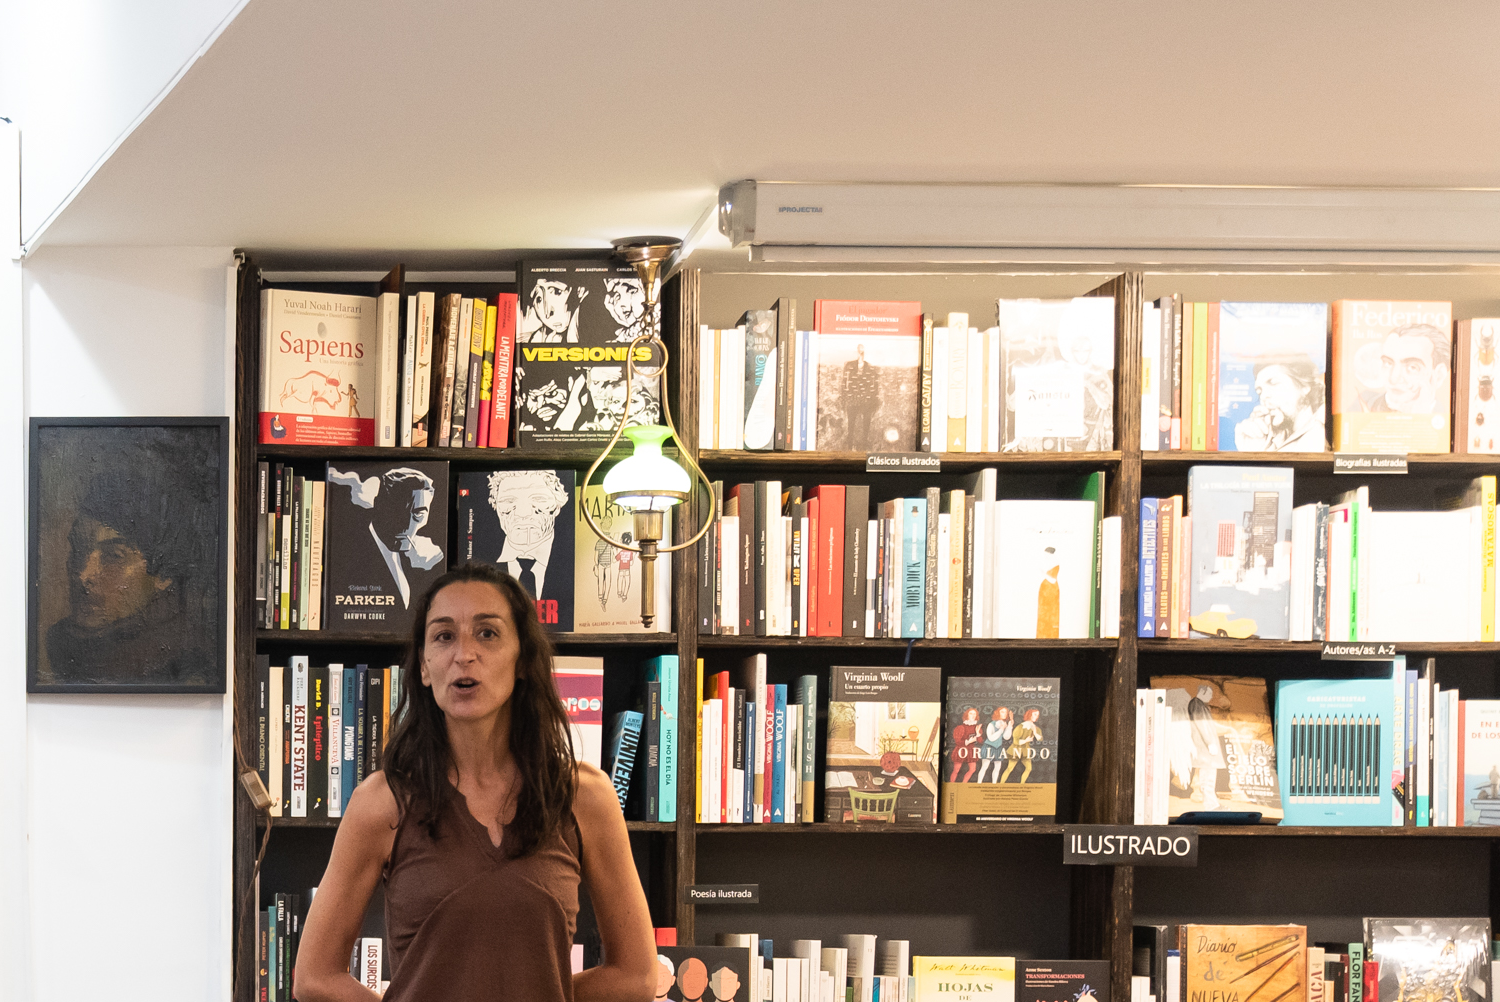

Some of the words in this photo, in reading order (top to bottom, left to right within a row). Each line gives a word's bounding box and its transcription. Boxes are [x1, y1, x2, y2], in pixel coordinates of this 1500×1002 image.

[284, 299, 306, 309] Yuval
[309, 301, 331, 311] Noah
[335, 303, 361, 313] Harari
[1351, 303, 1448, 328] Federico
[280, 331, 363, 362] Sapiens
[523, 347, 652, 361] VERSIONES
[868, 456, 900, 466] Clásicos
[901, 455, 939, 468] ilustrados
[1336, 458, 1371, 468] Biografías
[1372, 458, 1407, 468] ilustradas
[907, 561, 919, 583] DICK
[335, 595, 395, 605] PARKER
[907, 585, 920, 608] MOBY
[1323, 644, 1375, 655] Autores/as:
[1377, 644, 1396, 655] A-Z
[845, 672, 878, 683] Virginia
[881, 672, 905, 681] Woolf
[295, 705, 305, 744] KENT
[766, 710, 774, 742] WOOLF
[776, 709, 784, 741] WOOLF
[958, 748, 1049, 759] ORLANDO
[294, 747, 305, 791] STATE
[1071, 835, 1190, 856] ILUSTRADO
[691, 889, 716, 898] Poesía
[718, 889, 752, 898] ilustrada
[1352, 951, 1361, 979] FLOR
[938, 983, 993, 992] HOJAS
